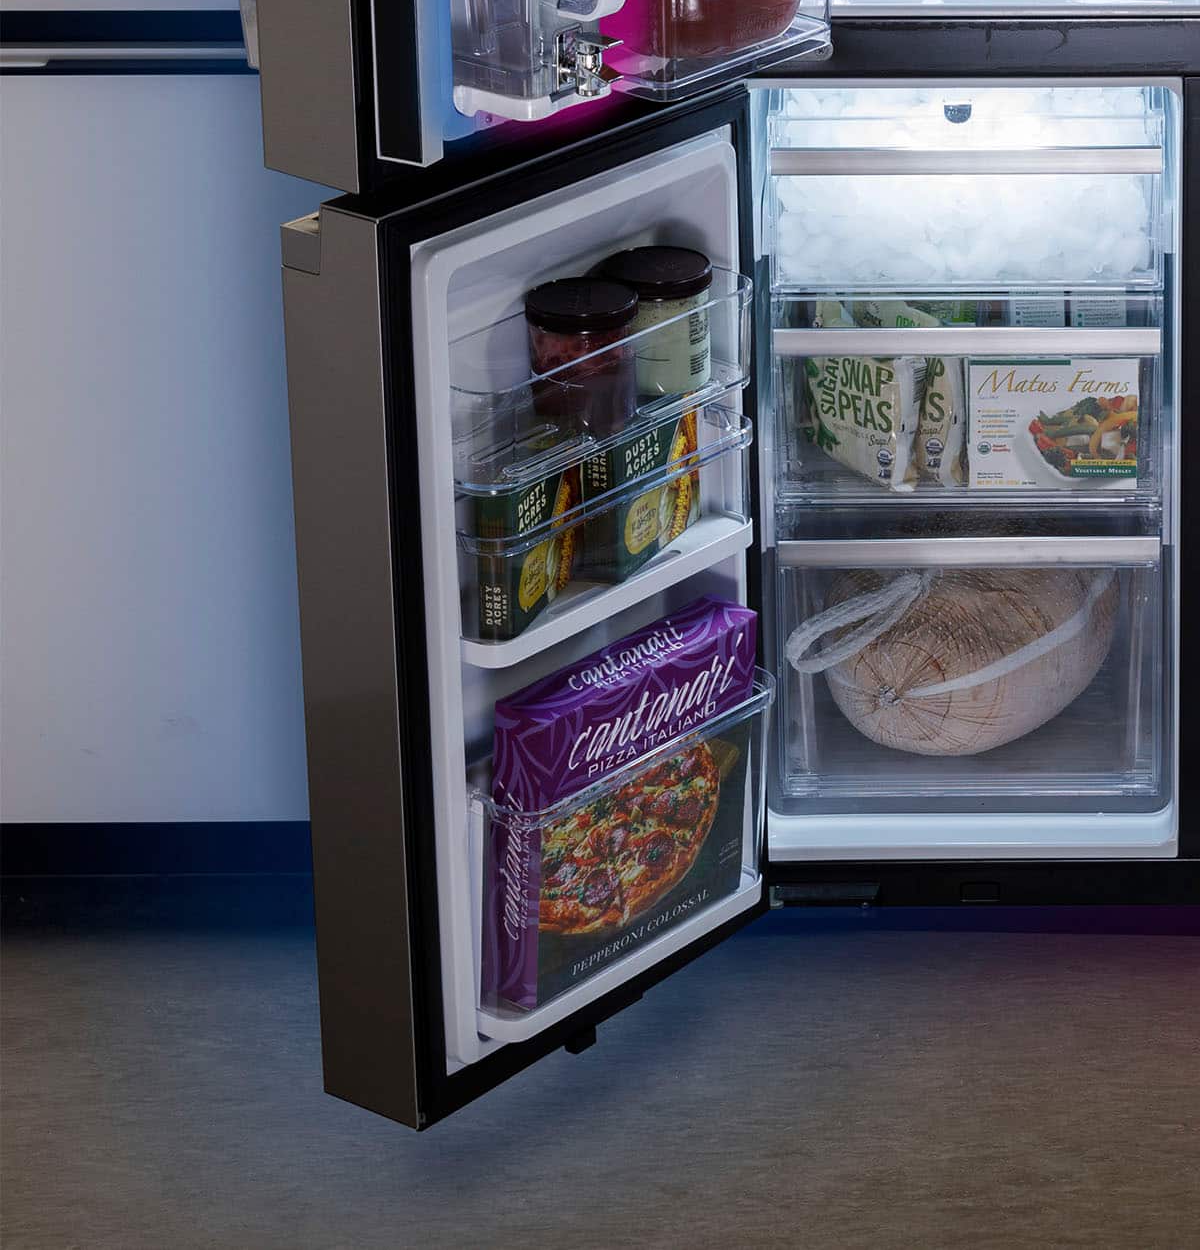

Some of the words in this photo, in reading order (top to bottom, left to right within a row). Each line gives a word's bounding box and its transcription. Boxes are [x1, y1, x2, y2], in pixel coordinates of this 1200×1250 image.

[840, 357, 894, 397] SNAP
[977, 369, 1058, 396] Matus
[1067, 368, 1130, 394] Farms
[838, 389, 893, 433] PEAS
[625, 428, 658, 463] DUSTY
[626, 442, 660, 477] ACRES
[592, 457, 600, 488] CRES
[518, 480, 546, 517] DUSTY
[518, 494, 546, 533] ACRES
[486, 585, 494, 625] DUSTY
[494, 586, 502, 626] ACRES
[593, 669, 631, 690] PIZZA
[631, 641, 685, 672] ITALIANO
[588, 745, 637, 778] PIZZA
[643, 700, 717, 750] ITALIANO
[520, 888, 529, 930] PIZZA
[571, 925, 645, 976] PEPPERONI
[646, 888, 710, 931] COLOSSAL
